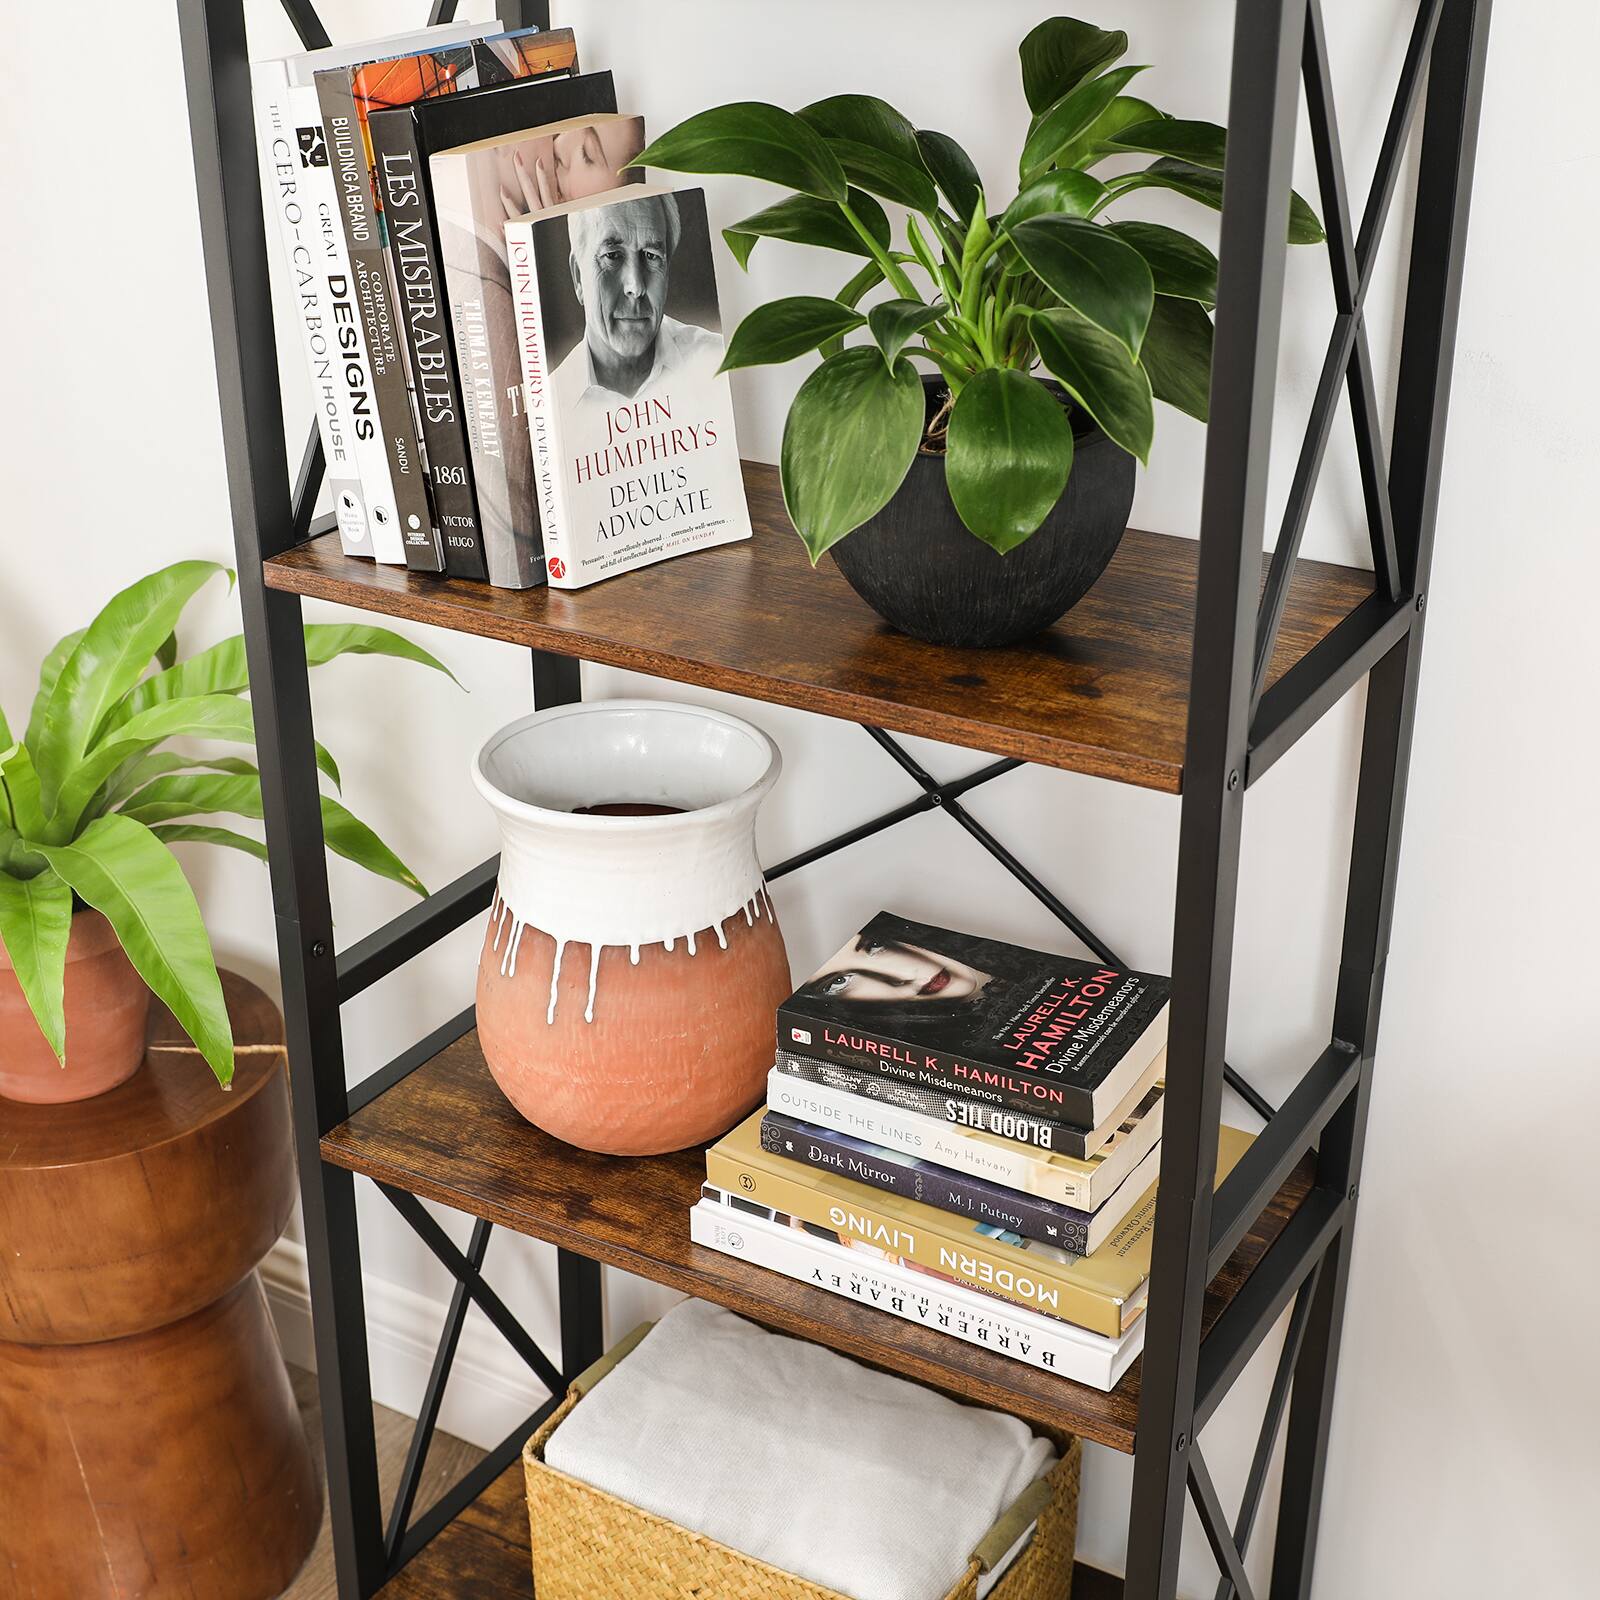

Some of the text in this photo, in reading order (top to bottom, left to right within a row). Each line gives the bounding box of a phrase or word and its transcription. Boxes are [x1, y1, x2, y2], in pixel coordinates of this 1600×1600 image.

[331, 116, 358, 182] BUILDING
[270, 104, 282, 132] THE
[322, 386, 346, 462] HOUSE
[382, 150, 455, 424] LES MISERABLES
[510, 241, 532, 294] JOHN
[318, 202, 374, 441] GREAT DESIGNS
[355, 260, 386, 376] ARCHITECTURE
[370, 271, 396, 362] CORPORATE
[454, 304, 480, 454] The Office of Innocence
[464, 299, 500, 458] THOMAS KENEALLY
[520, 302, 546, 408] HUMPHRYS
[575, 420, 717, 484] HUMPHRYS
[606, 395, 672, 446] JOHN
[394, 437, 410, 474] SANDU
[434, 466, 467, 486] 1861
[610, 466, 688, 508] DEVIL'S
[442, 516, 475, 528] VICTOR
[541, 470, 558, 542] ADVOCATE
[596, 488, 712, 543] ADVOCATE
[641, 534, 662, 546] observed
[670, 525, 694, 538] extremely
[694, 518, 726, 530] well-written
[692, 530, 716, 542] SUNDAY
[448, 536, 474, 548] HUGO
[622, 550, 648, 564] intellectual
[992, 1031, 1004, 1041] The
[1012, 1008, 1022, 1022] New
[1019, 1000, 1030, 1013] York
[1027, 990, 1040, 1006] Times
[1037, 976, 1056, 996] bestseller
[1003, 976, 1083, 1050] LAURELL K.
[1016, 969, 1120, 1070] HAMILTON
[1044, 976, 1140, 1074] Divine Misdemeanors
[1078, 1052, 1091, 1068] seems
[1087, 1033, 1106, 1057] immortals
[1104, 1026, 1114, 1038] can
[1110, 1020, 1118, 1031] be
[1115, 1002, 1133, 1024] murdered
[1130, 993, 1140, 1007] after
[822, 1076, 858, 1090] CLAUDIO
[824, 1029, 1064, 1104] LAURELL K. HAMILTON
[880, 1060, 1003, 1103] Divine Misdemeanors
[780, 1092, 1013, 1176] OUTSIDE THE LINES Amy Hatvany
[946, 1099, 1052, 1149] BLOOD TIES
[808, 1144, 1024, 1226] Dark Mirror M. J. Putney
[829, 1206, 1059, 1309] MODERN LIVING
[1116, 1224, 1152, 1258] Restaurant
[812, 1268, 1056, 1368] BARBERA BAREY
[937, 1302, 953, 1314] BY
[958, 1310, 1031, 1342] REALIZED
